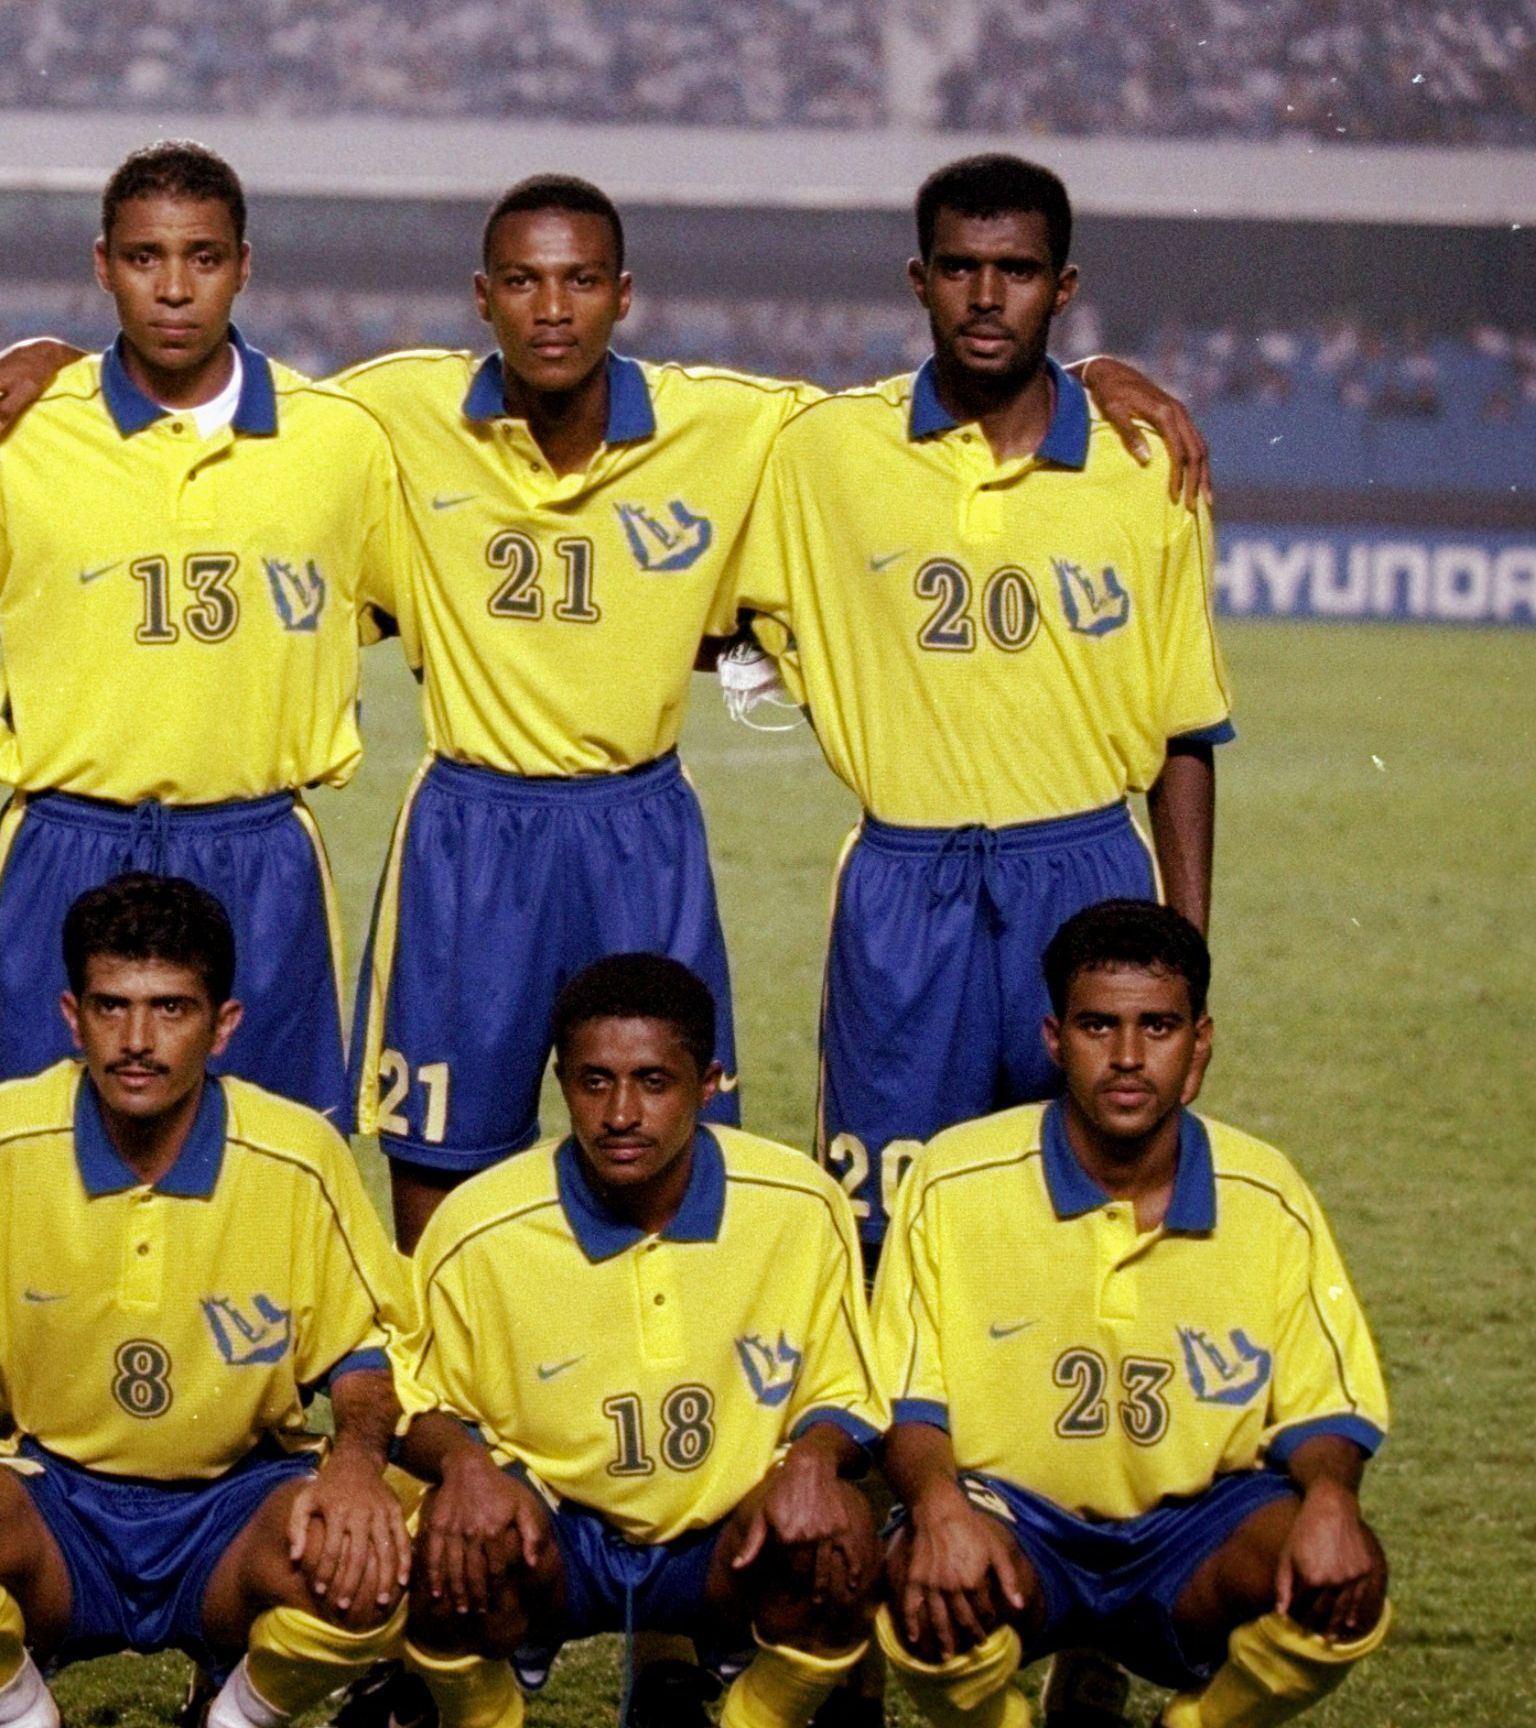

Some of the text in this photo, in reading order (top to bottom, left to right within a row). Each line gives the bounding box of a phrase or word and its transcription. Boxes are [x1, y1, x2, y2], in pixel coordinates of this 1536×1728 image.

[129, 552, 240, 643] 13
[486, 530, 601, 624] 21
[915, 557, 1040, 652] 20
[377, 1049, 448, 1142] 21
[114, 1339, 173, 1418] 8
[1054, 1346, 1172, 1446] 23
[604, 1384, 716, 1477] 18
